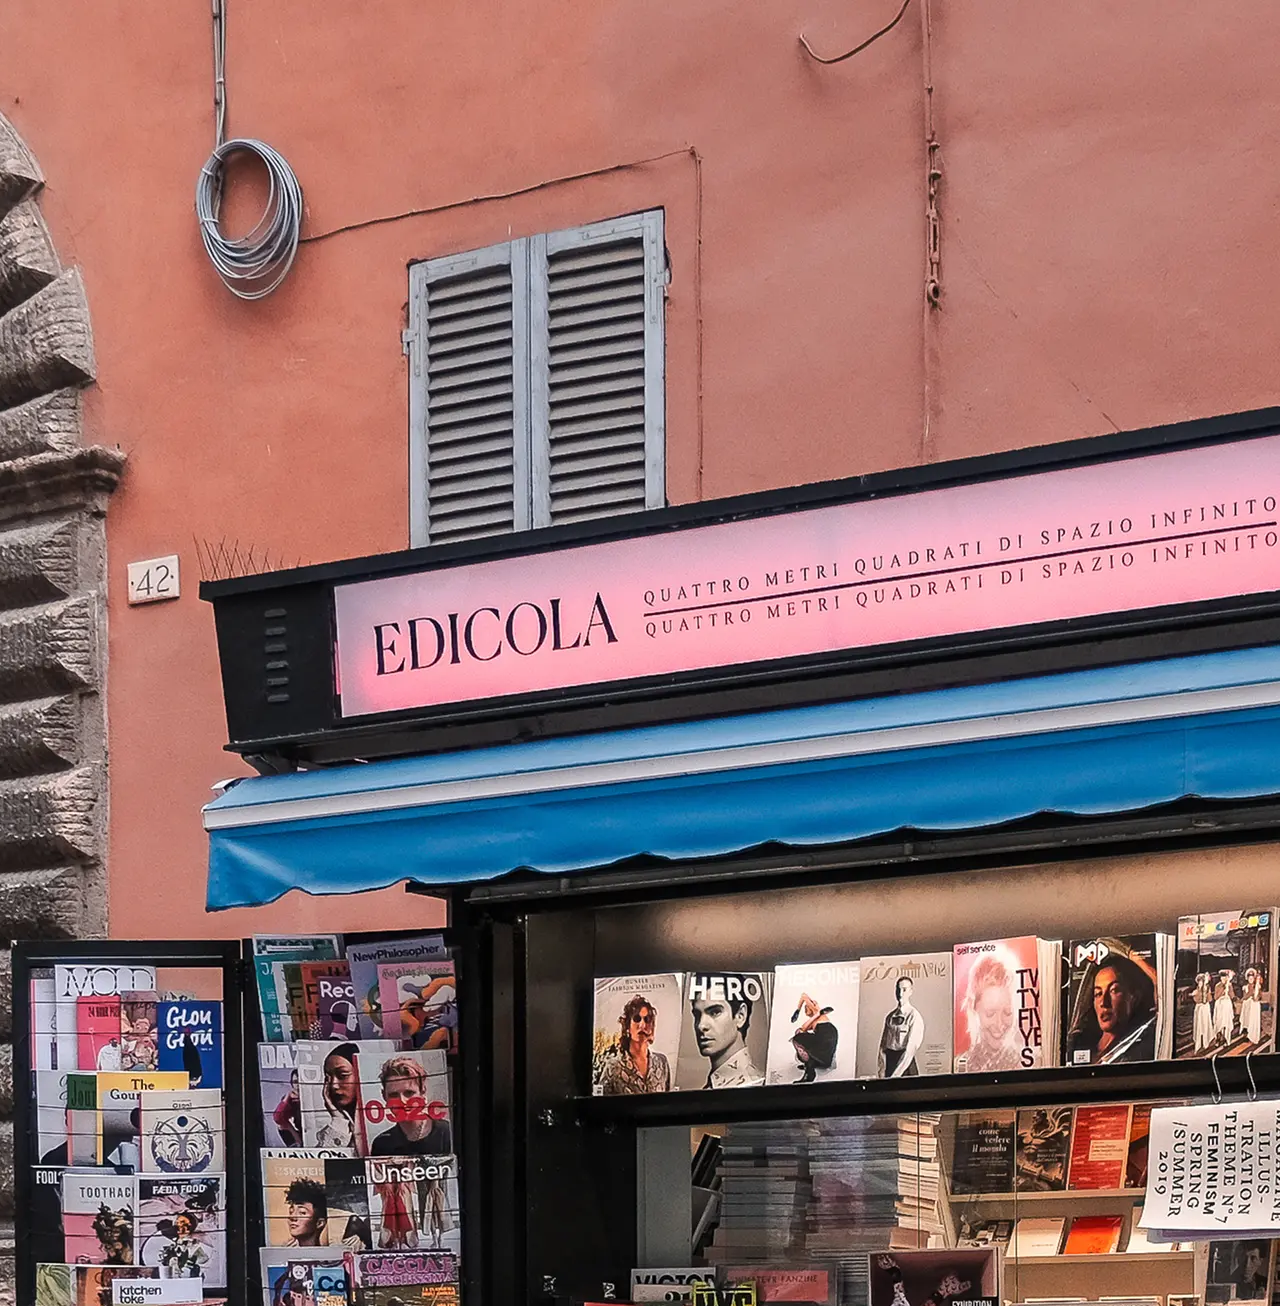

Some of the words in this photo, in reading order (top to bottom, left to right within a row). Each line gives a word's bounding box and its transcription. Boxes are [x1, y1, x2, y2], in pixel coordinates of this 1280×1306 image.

[643, 576, 751, 606] QUATTRO
[764, 562, 840, 587] METRI
[854, 540, 984, 576] QUADRATI
[998, 533, 1025, 552] DI
[1039, 515, 1134, 546] SPAZIO
[1150, 496, 1278, 530] INFINITO
[135, 564, 170, 596] 42
[645, 609, 753, 639] QUATTRO
[766, 596, 841, 620] METRI
[856, 574, 985, 610] QUADRATI
[1000, 568, 1026, 585] DI
[1041, 551, 1136, 580] SPAZIO
[1151, 530, 1280, 564] INFINITO
[372, 591, 619, 677] EDICOLA
[352, 943, 441, 963] NewPhilosopher
[1074, 941, 1110, 968] POP
[688, 976, 762, 1001] HERO
[1020, 1047, 1034, 1068] S
[131, 1077, 155, 1091] The
[364, 1096, 448, 1124] 032c
[1222, 1110, 1238, 1186] THEME
[370, 1163, 452, 1184] Unseen
[1154, 1150, 1168, 1196] 2019
[1167, 1121, 1188, 1218] /SUMMER
[1187, 1132, 1203, 1209] SPRING
[1202, 1122, 1220, 1216] FEMINISM
[1237, 1120, 1254, 1215] TRATION
[1257, 1130, 1271, 1204] ILLUS-
[1214, 1216, 1228, 1224] 7
[119, 1285, 162, 1297] kitchen
[781, 1274, 819, 1283] FANZINE
[119, 1295, 145, 1304] toke
